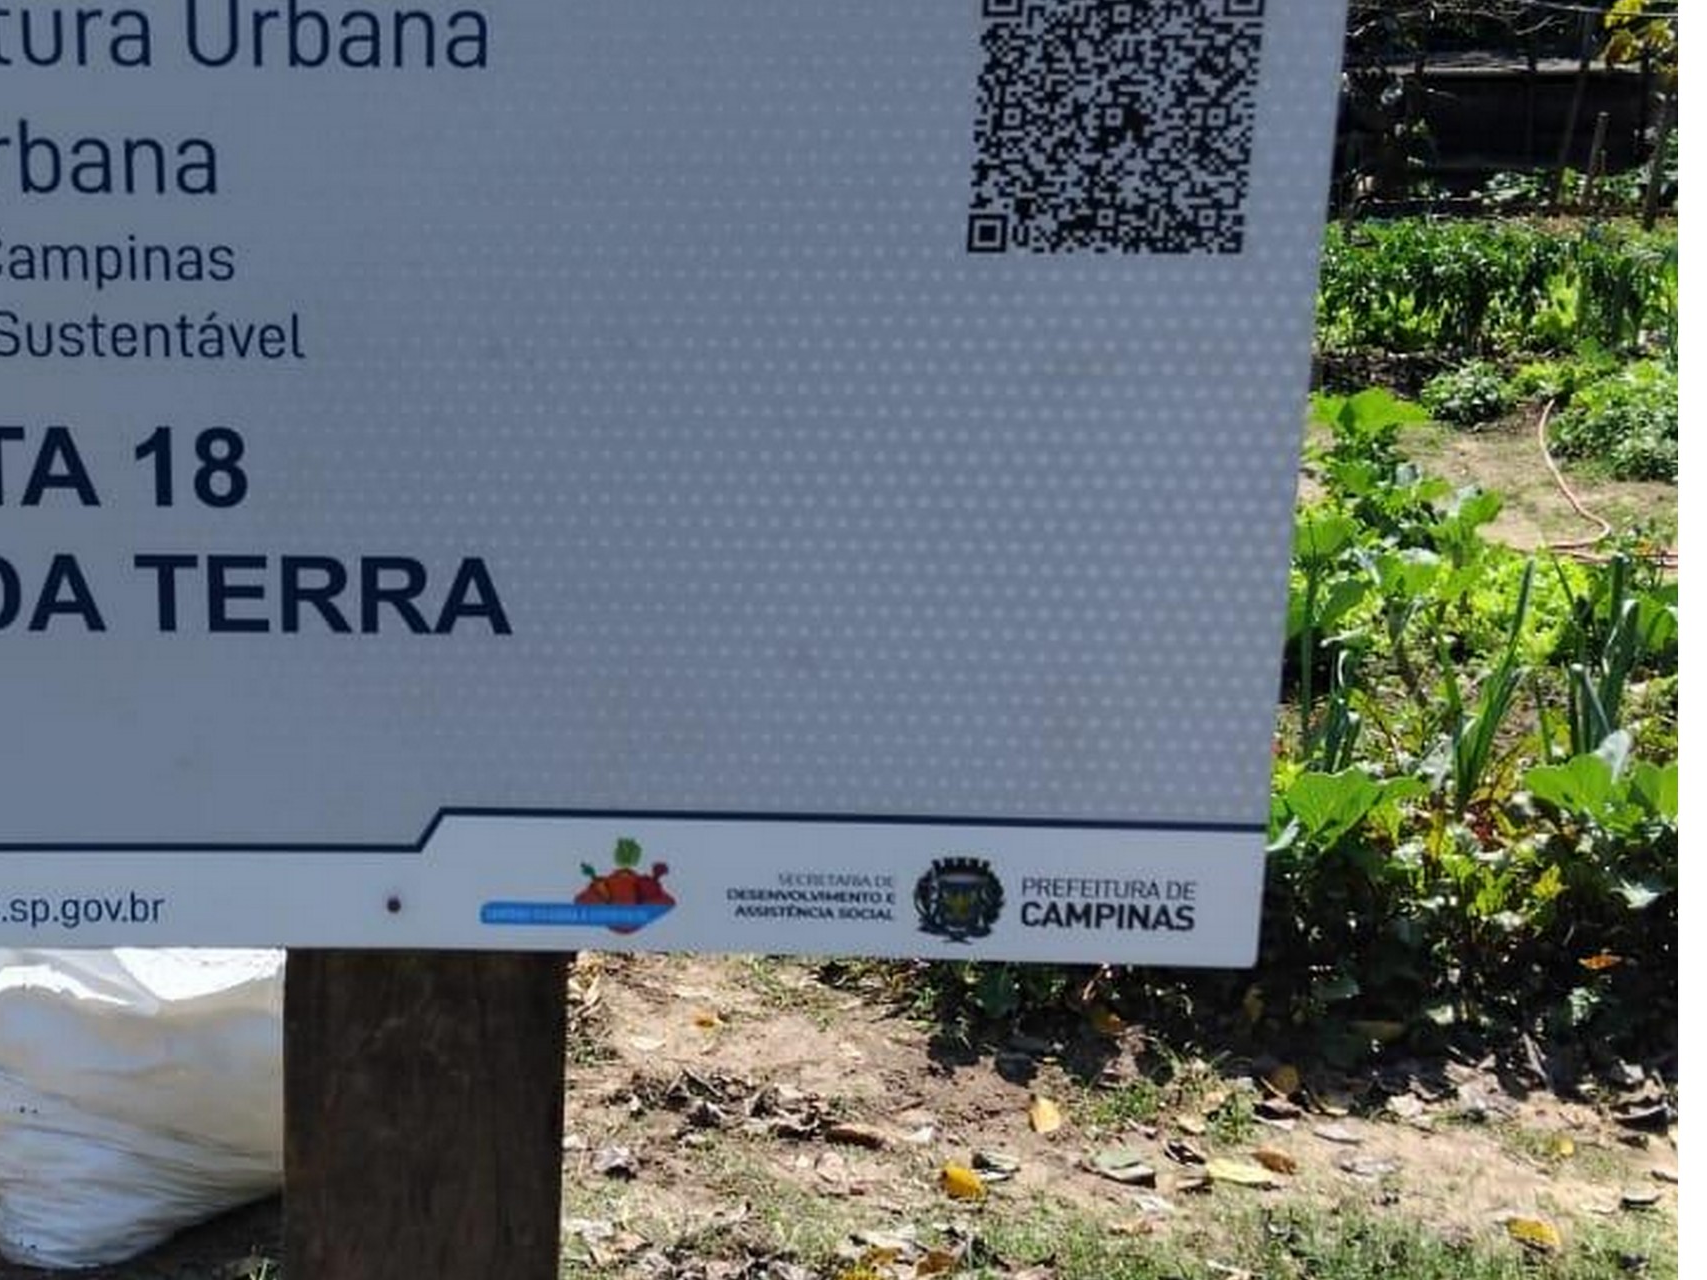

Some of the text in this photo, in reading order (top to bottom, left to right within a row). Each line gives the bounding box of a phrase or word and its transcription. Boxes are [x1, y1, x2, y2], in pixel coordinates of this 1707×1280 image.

[134, 425, 248, 509] 18
[133, 554, 513, 636] TERRA
[1022, 877, 1197, 900] PREFEITURA DE
[1021, 902, 1195, 931] CAMPINAS
